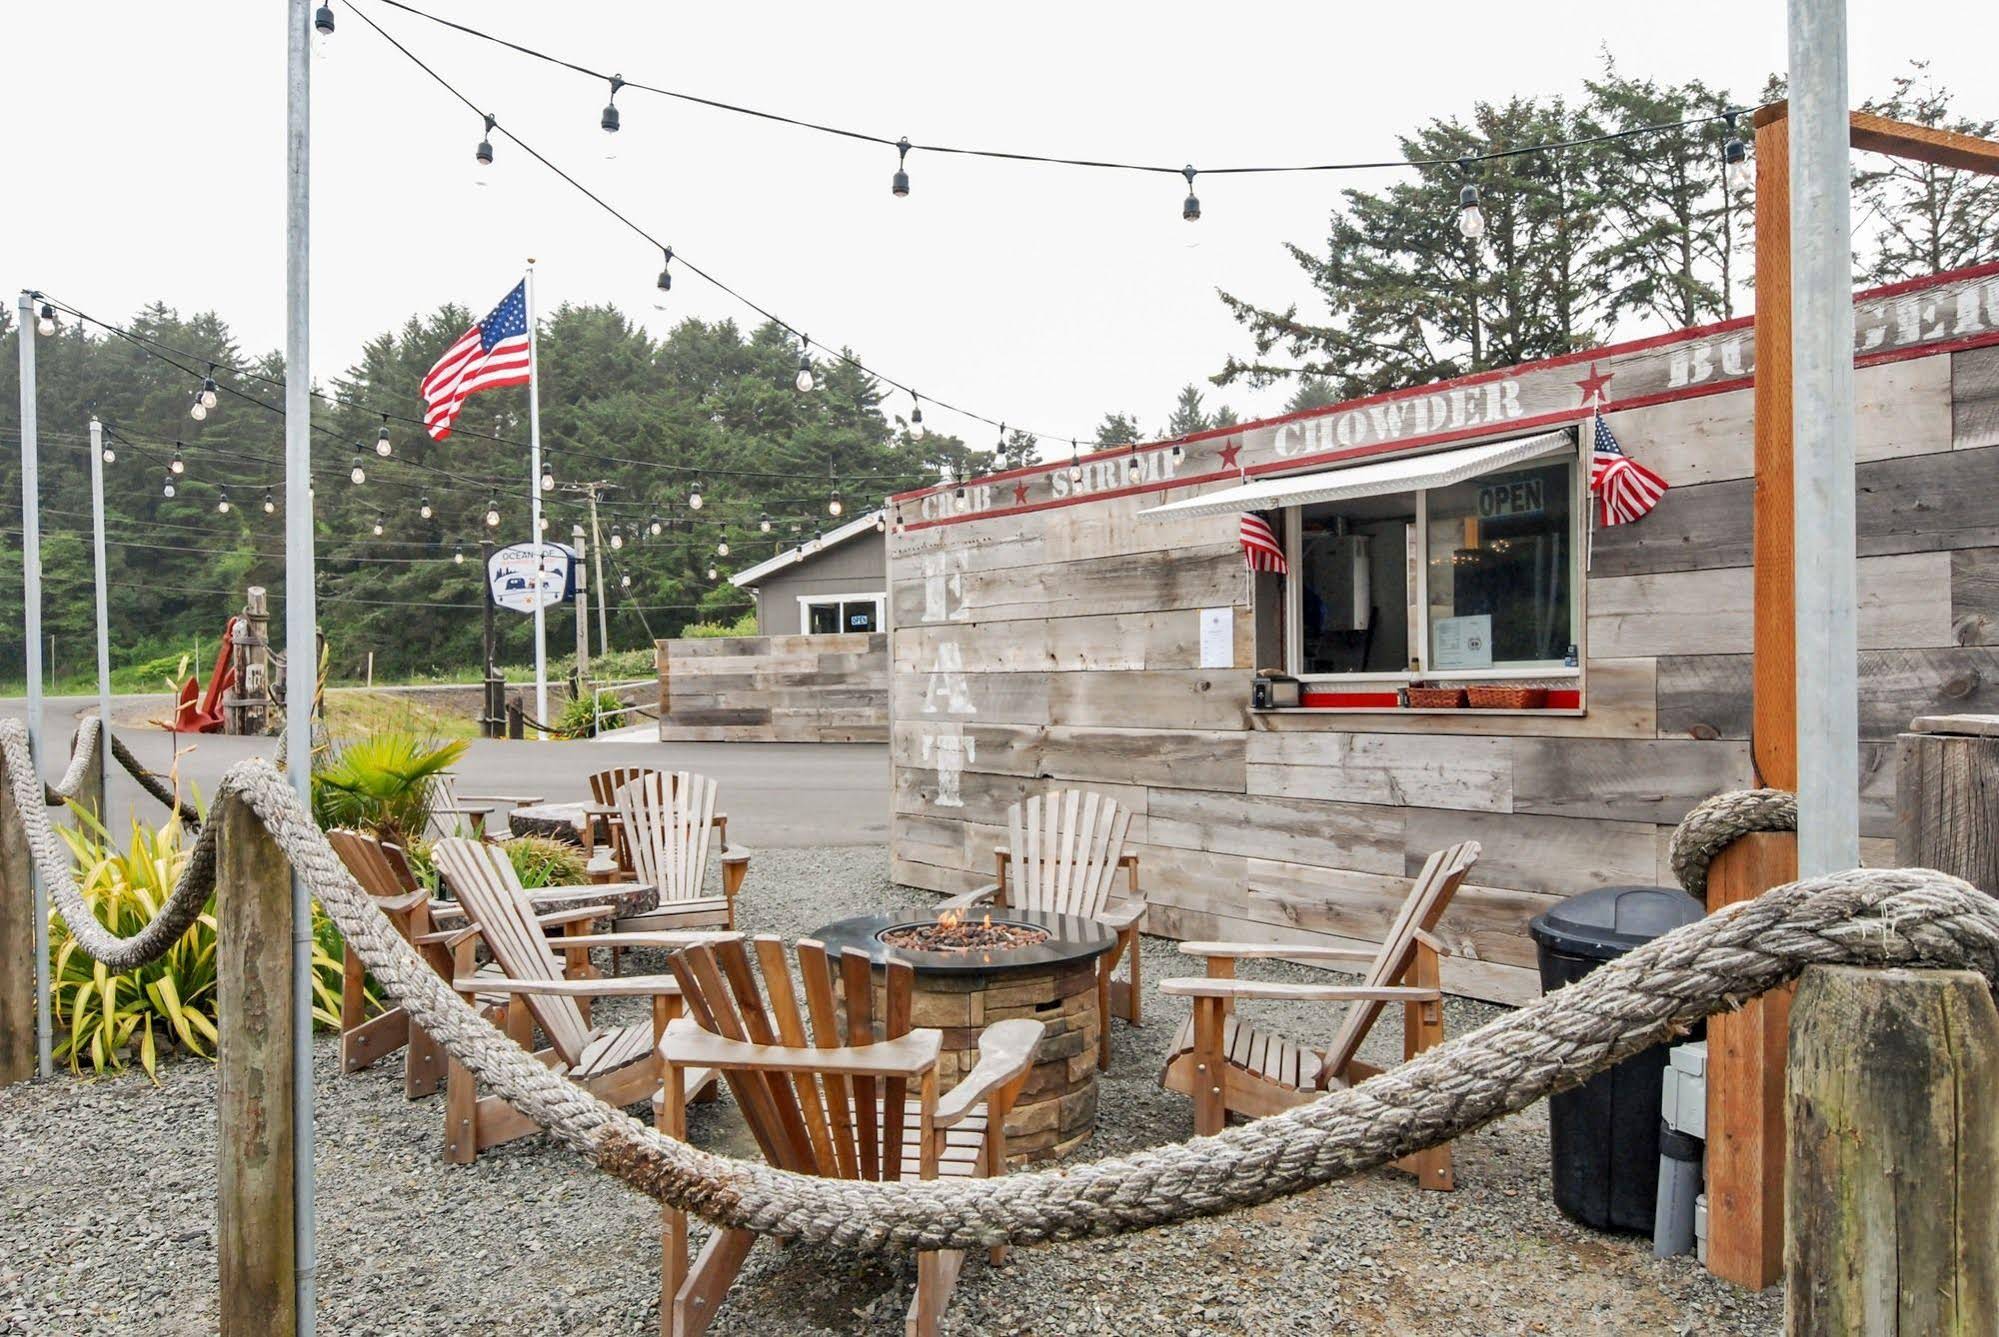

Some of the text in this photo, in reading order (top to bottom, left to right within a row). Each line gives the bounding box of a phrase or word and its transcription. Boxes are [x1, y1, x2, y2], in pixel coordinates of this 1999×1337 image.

[1273, 380, 1524, 458] CHOWDER
[1479, 480, 1543, 517] OPEN
[921, 550, 977, 807] EAT
